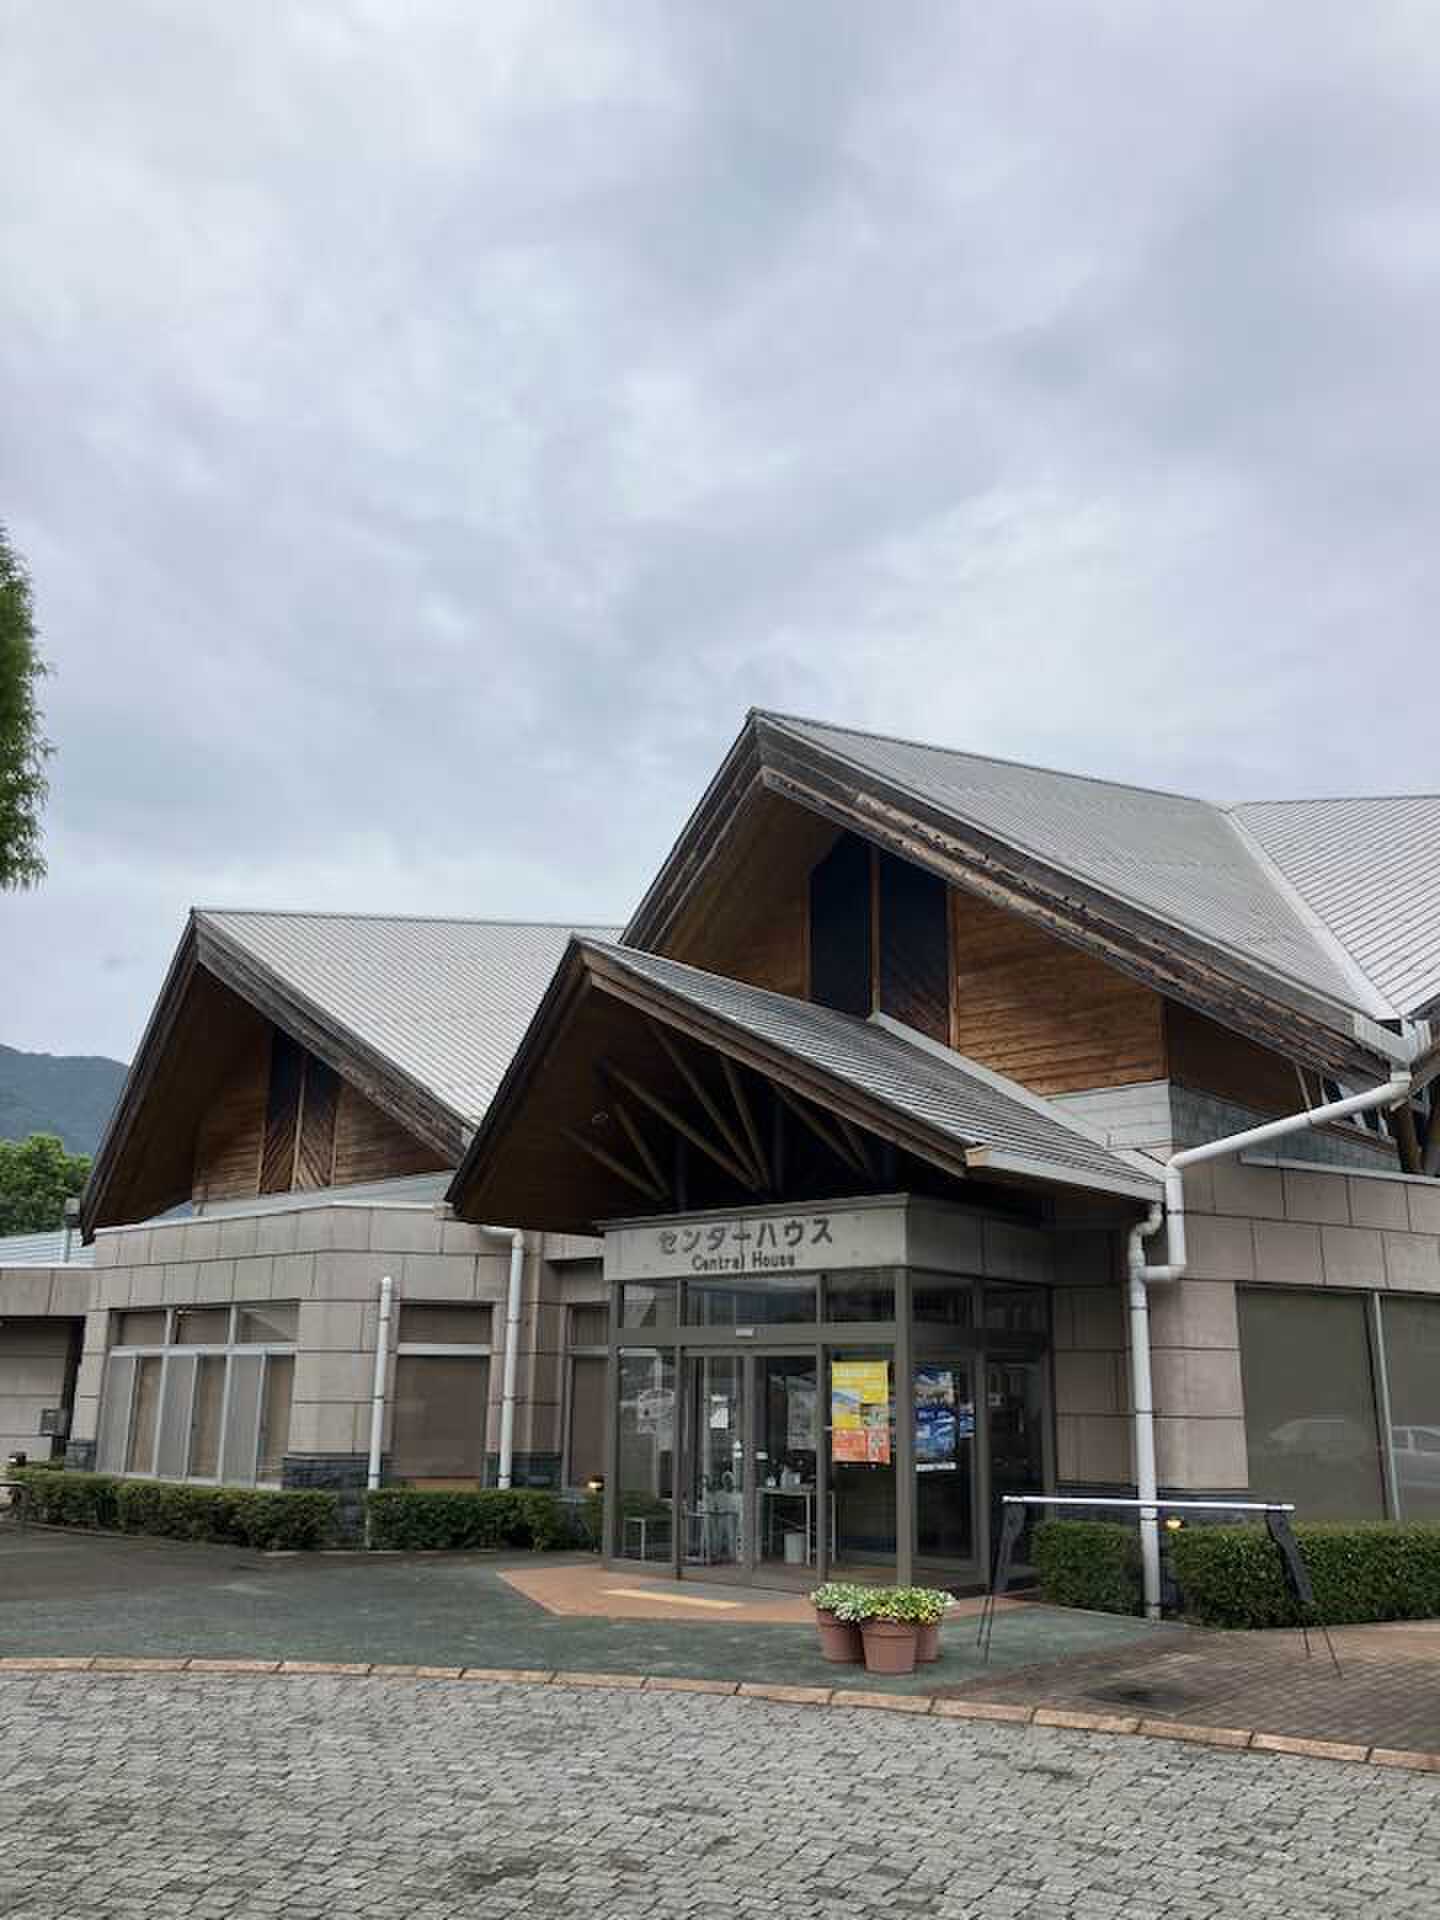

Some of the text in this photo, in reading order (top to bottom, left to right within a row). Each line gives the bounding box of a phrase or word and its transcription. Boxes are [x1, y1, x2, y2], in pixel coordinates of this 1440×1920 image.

[657, 1217, 833, 1255] センターハウス
[691, 1251, 796, 1272] Central House
